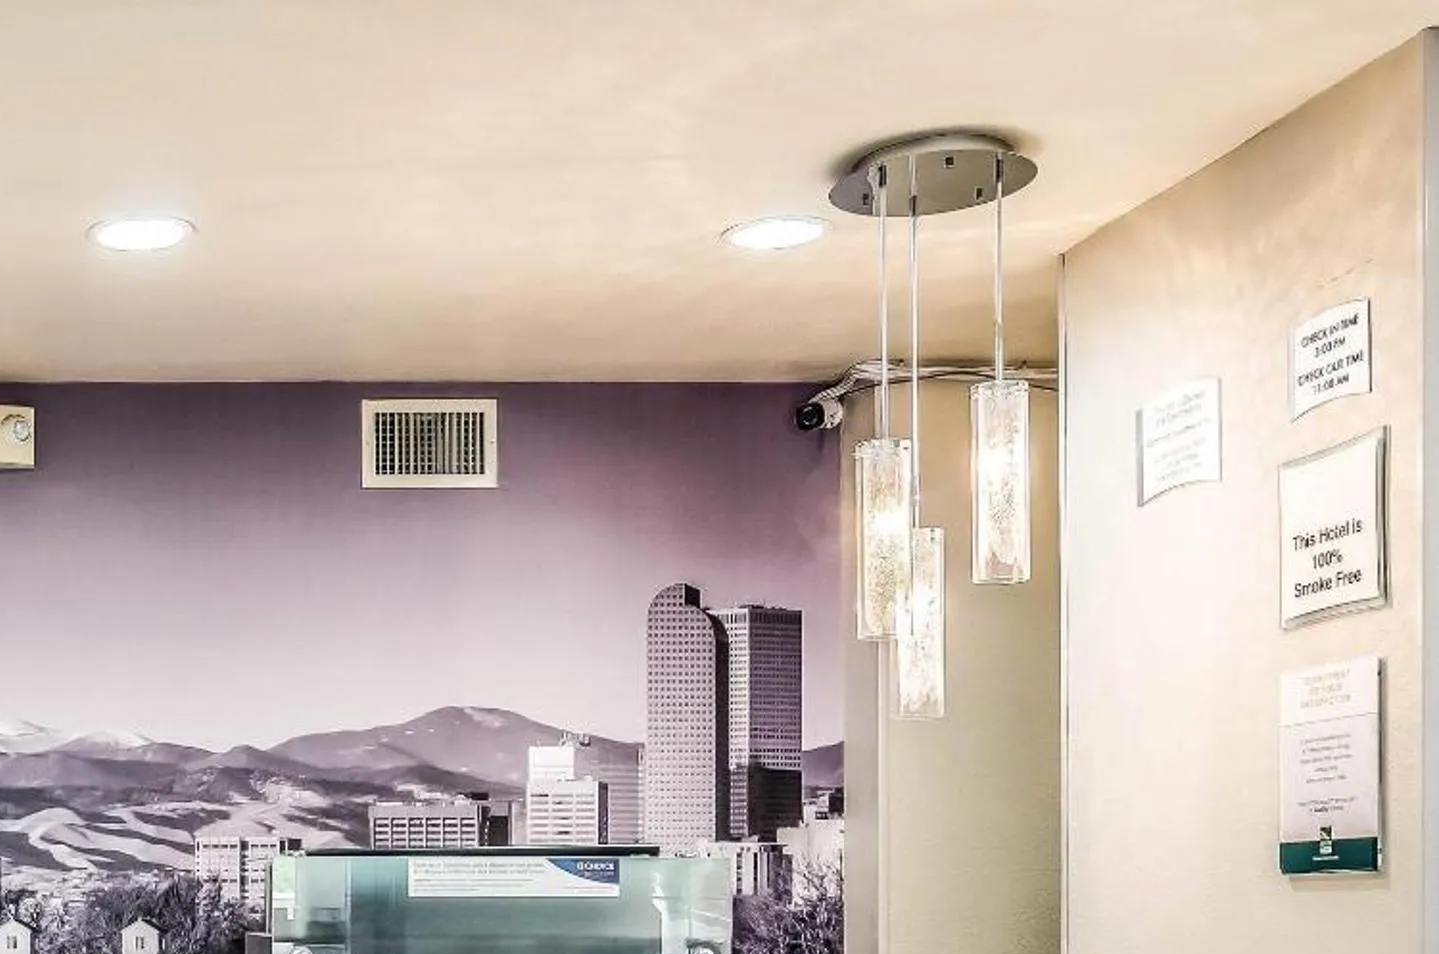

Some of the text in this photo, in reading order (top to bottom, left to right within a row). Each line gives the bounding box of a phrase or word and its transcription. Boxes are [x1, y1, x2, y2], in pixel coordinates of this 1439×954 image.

[1292, 518, 1363, 552] This Hotel is
[1312, 549, 1343, 569] 100%
[1294, 568, 1362, 598] Smoke Free
